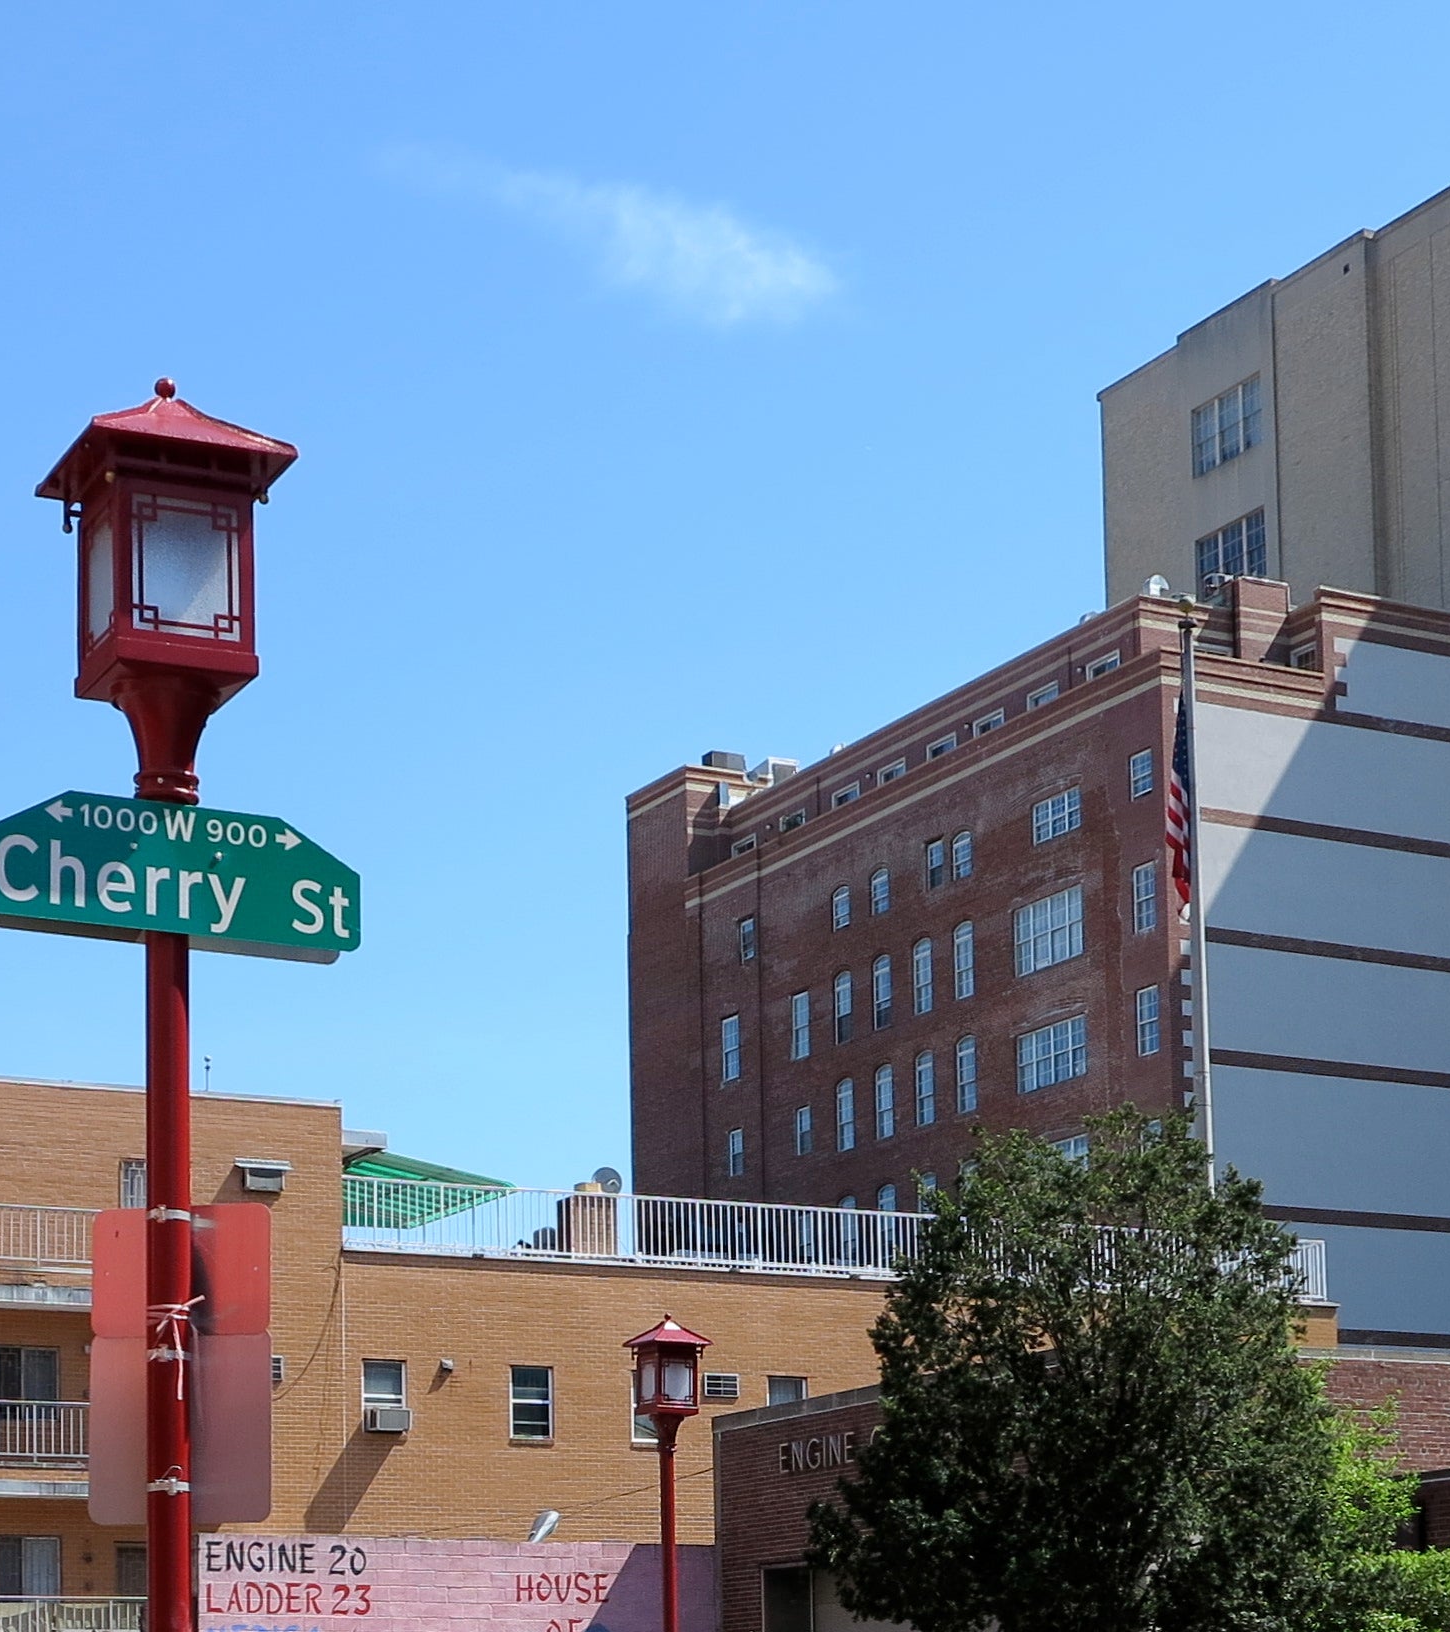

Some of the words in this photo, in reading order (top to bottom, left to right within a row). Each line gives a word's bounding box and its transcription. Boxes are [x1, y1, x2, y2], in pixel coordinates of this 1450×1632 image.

[79, 803, 157, 835] 1000
[163, 809, 196, 843] W
[206, 819, 267, 848] 900
[291, 879, 350, 939] St
[779, 1431, 855, 1473] ENGINE
[205, 1541, 316, 1574] ENGINE
[328, 1545, 367, 1576] 20
[206, 1581, 322, 1614] LADDER
[331, 1584, 372, 1615] 23
[515, 1572, 610, 1604] HOUSE
